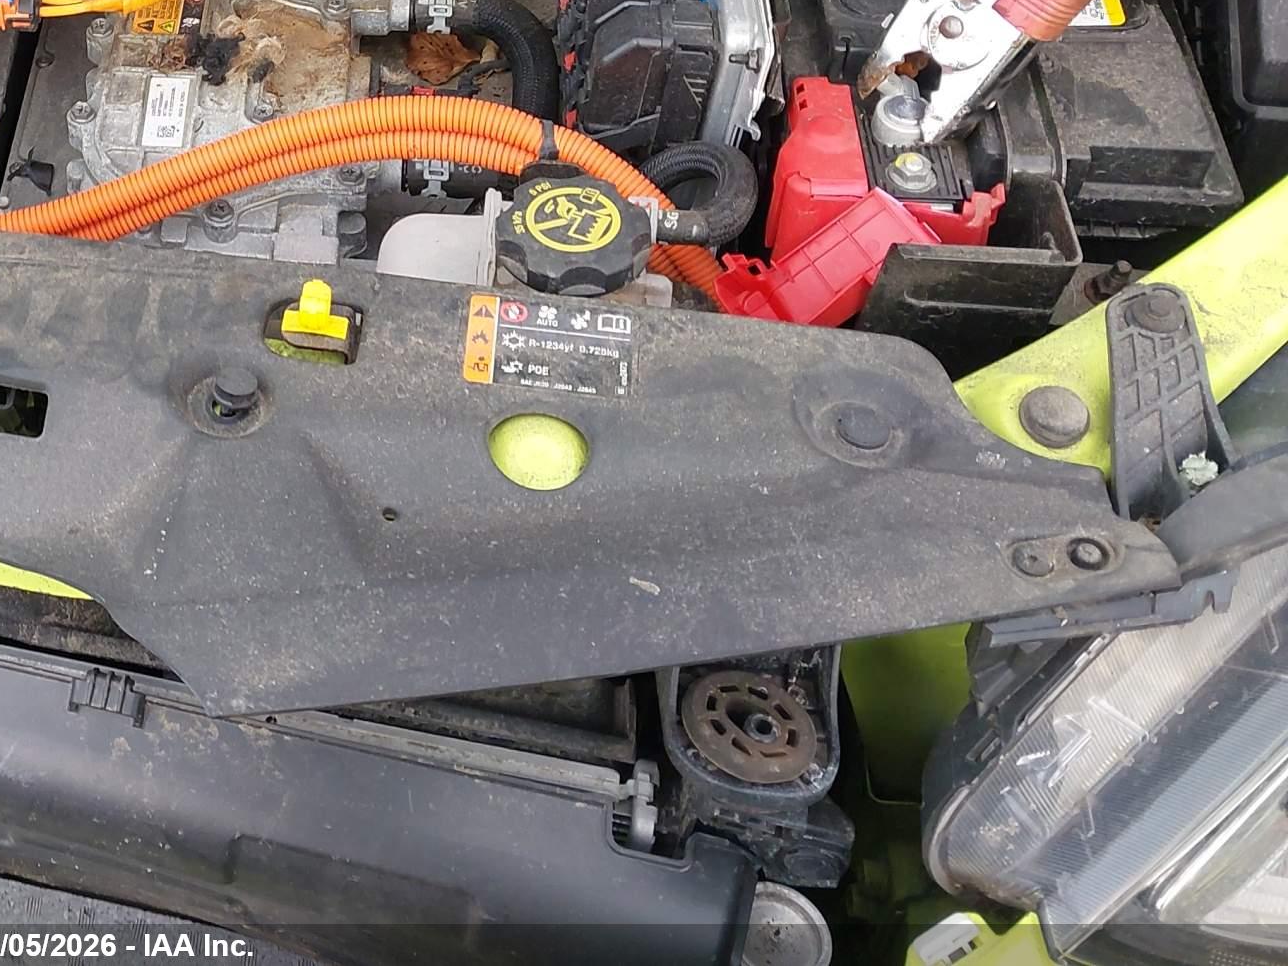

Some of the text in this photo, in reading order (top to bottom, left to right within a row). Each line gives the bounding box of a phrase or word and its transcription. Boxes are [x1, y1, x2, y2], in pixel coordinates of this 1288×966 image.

[537, 319, 559, 328] AUTO
[529, 338, 574, 354] R-1234yf
[528, 364, 550, 376] POE
